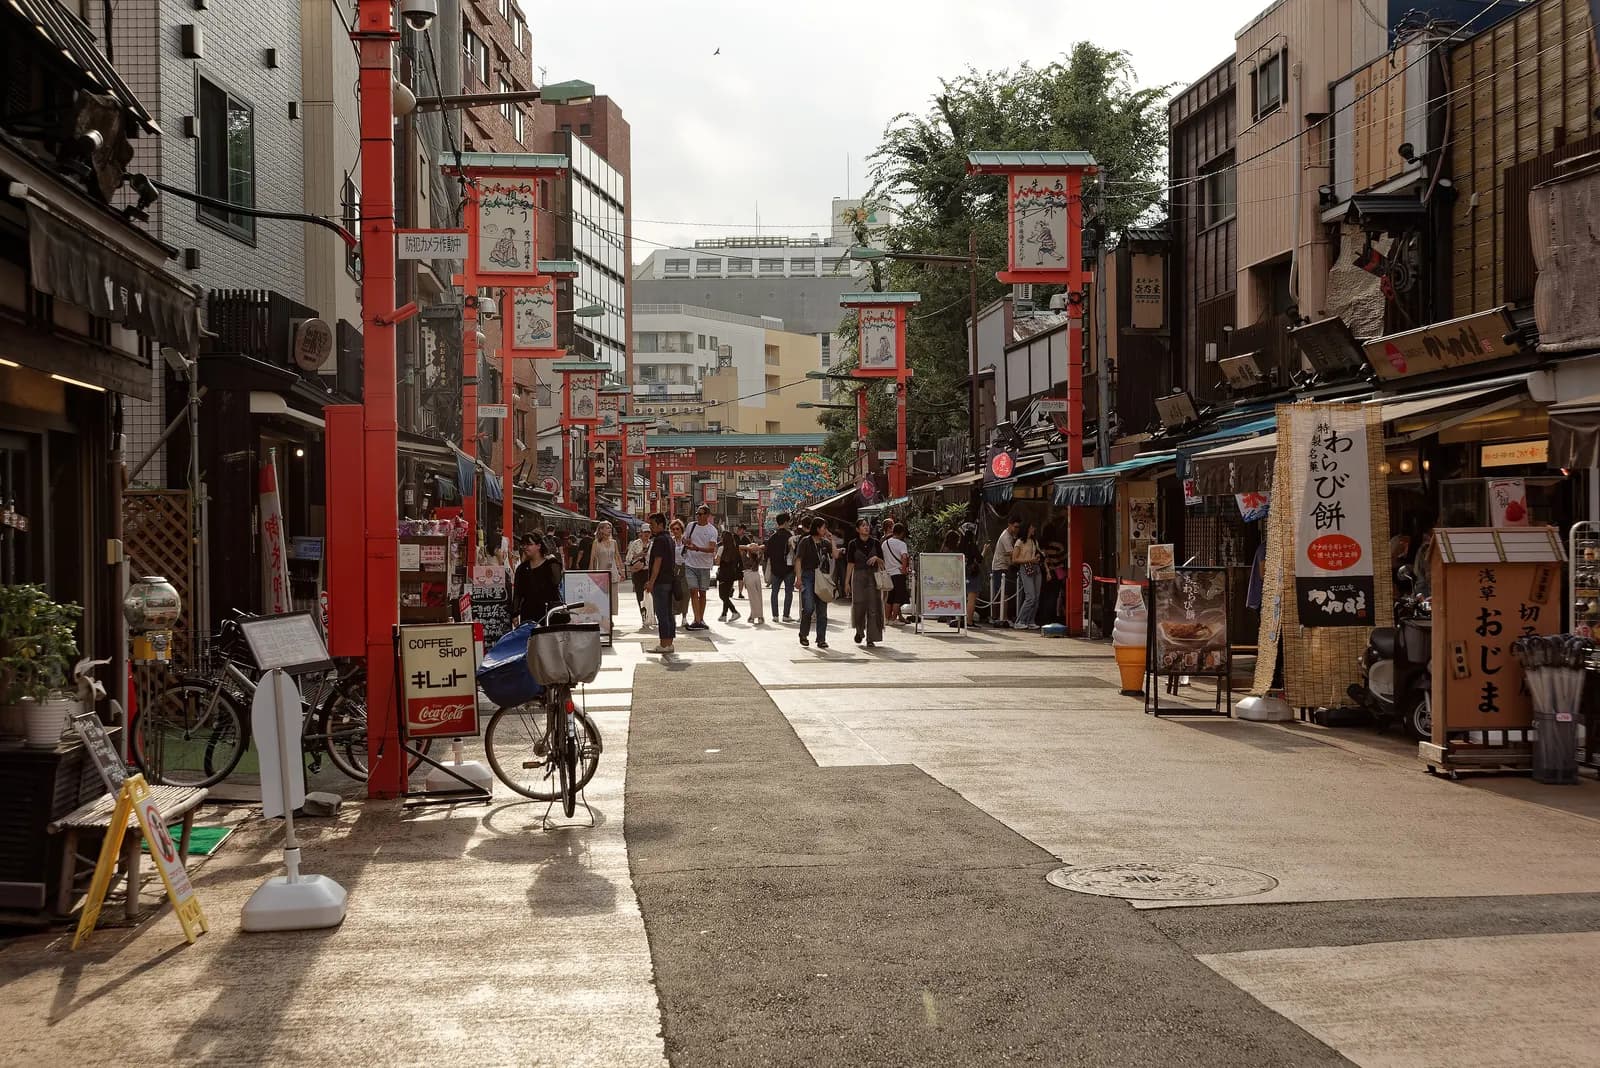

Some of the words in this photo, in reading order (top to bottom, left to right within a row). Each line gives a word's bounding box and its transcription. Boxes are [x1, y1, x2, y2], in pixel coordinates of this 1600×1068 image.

[405, 235, 461, 253] 防犯カメラ作動中
[1308, 422, 1330, 473] 特製名菓
[714, 450, 786, 464] 伝法院通
[1310, 430, 1353, 531] わらび餅
[409, 638, 453, 649] COFFEE
[439, 647, 467, 658] SHOP
[411, 668, 467, 689] キレット
[418, 704, 465, 722] Coca-Cola
